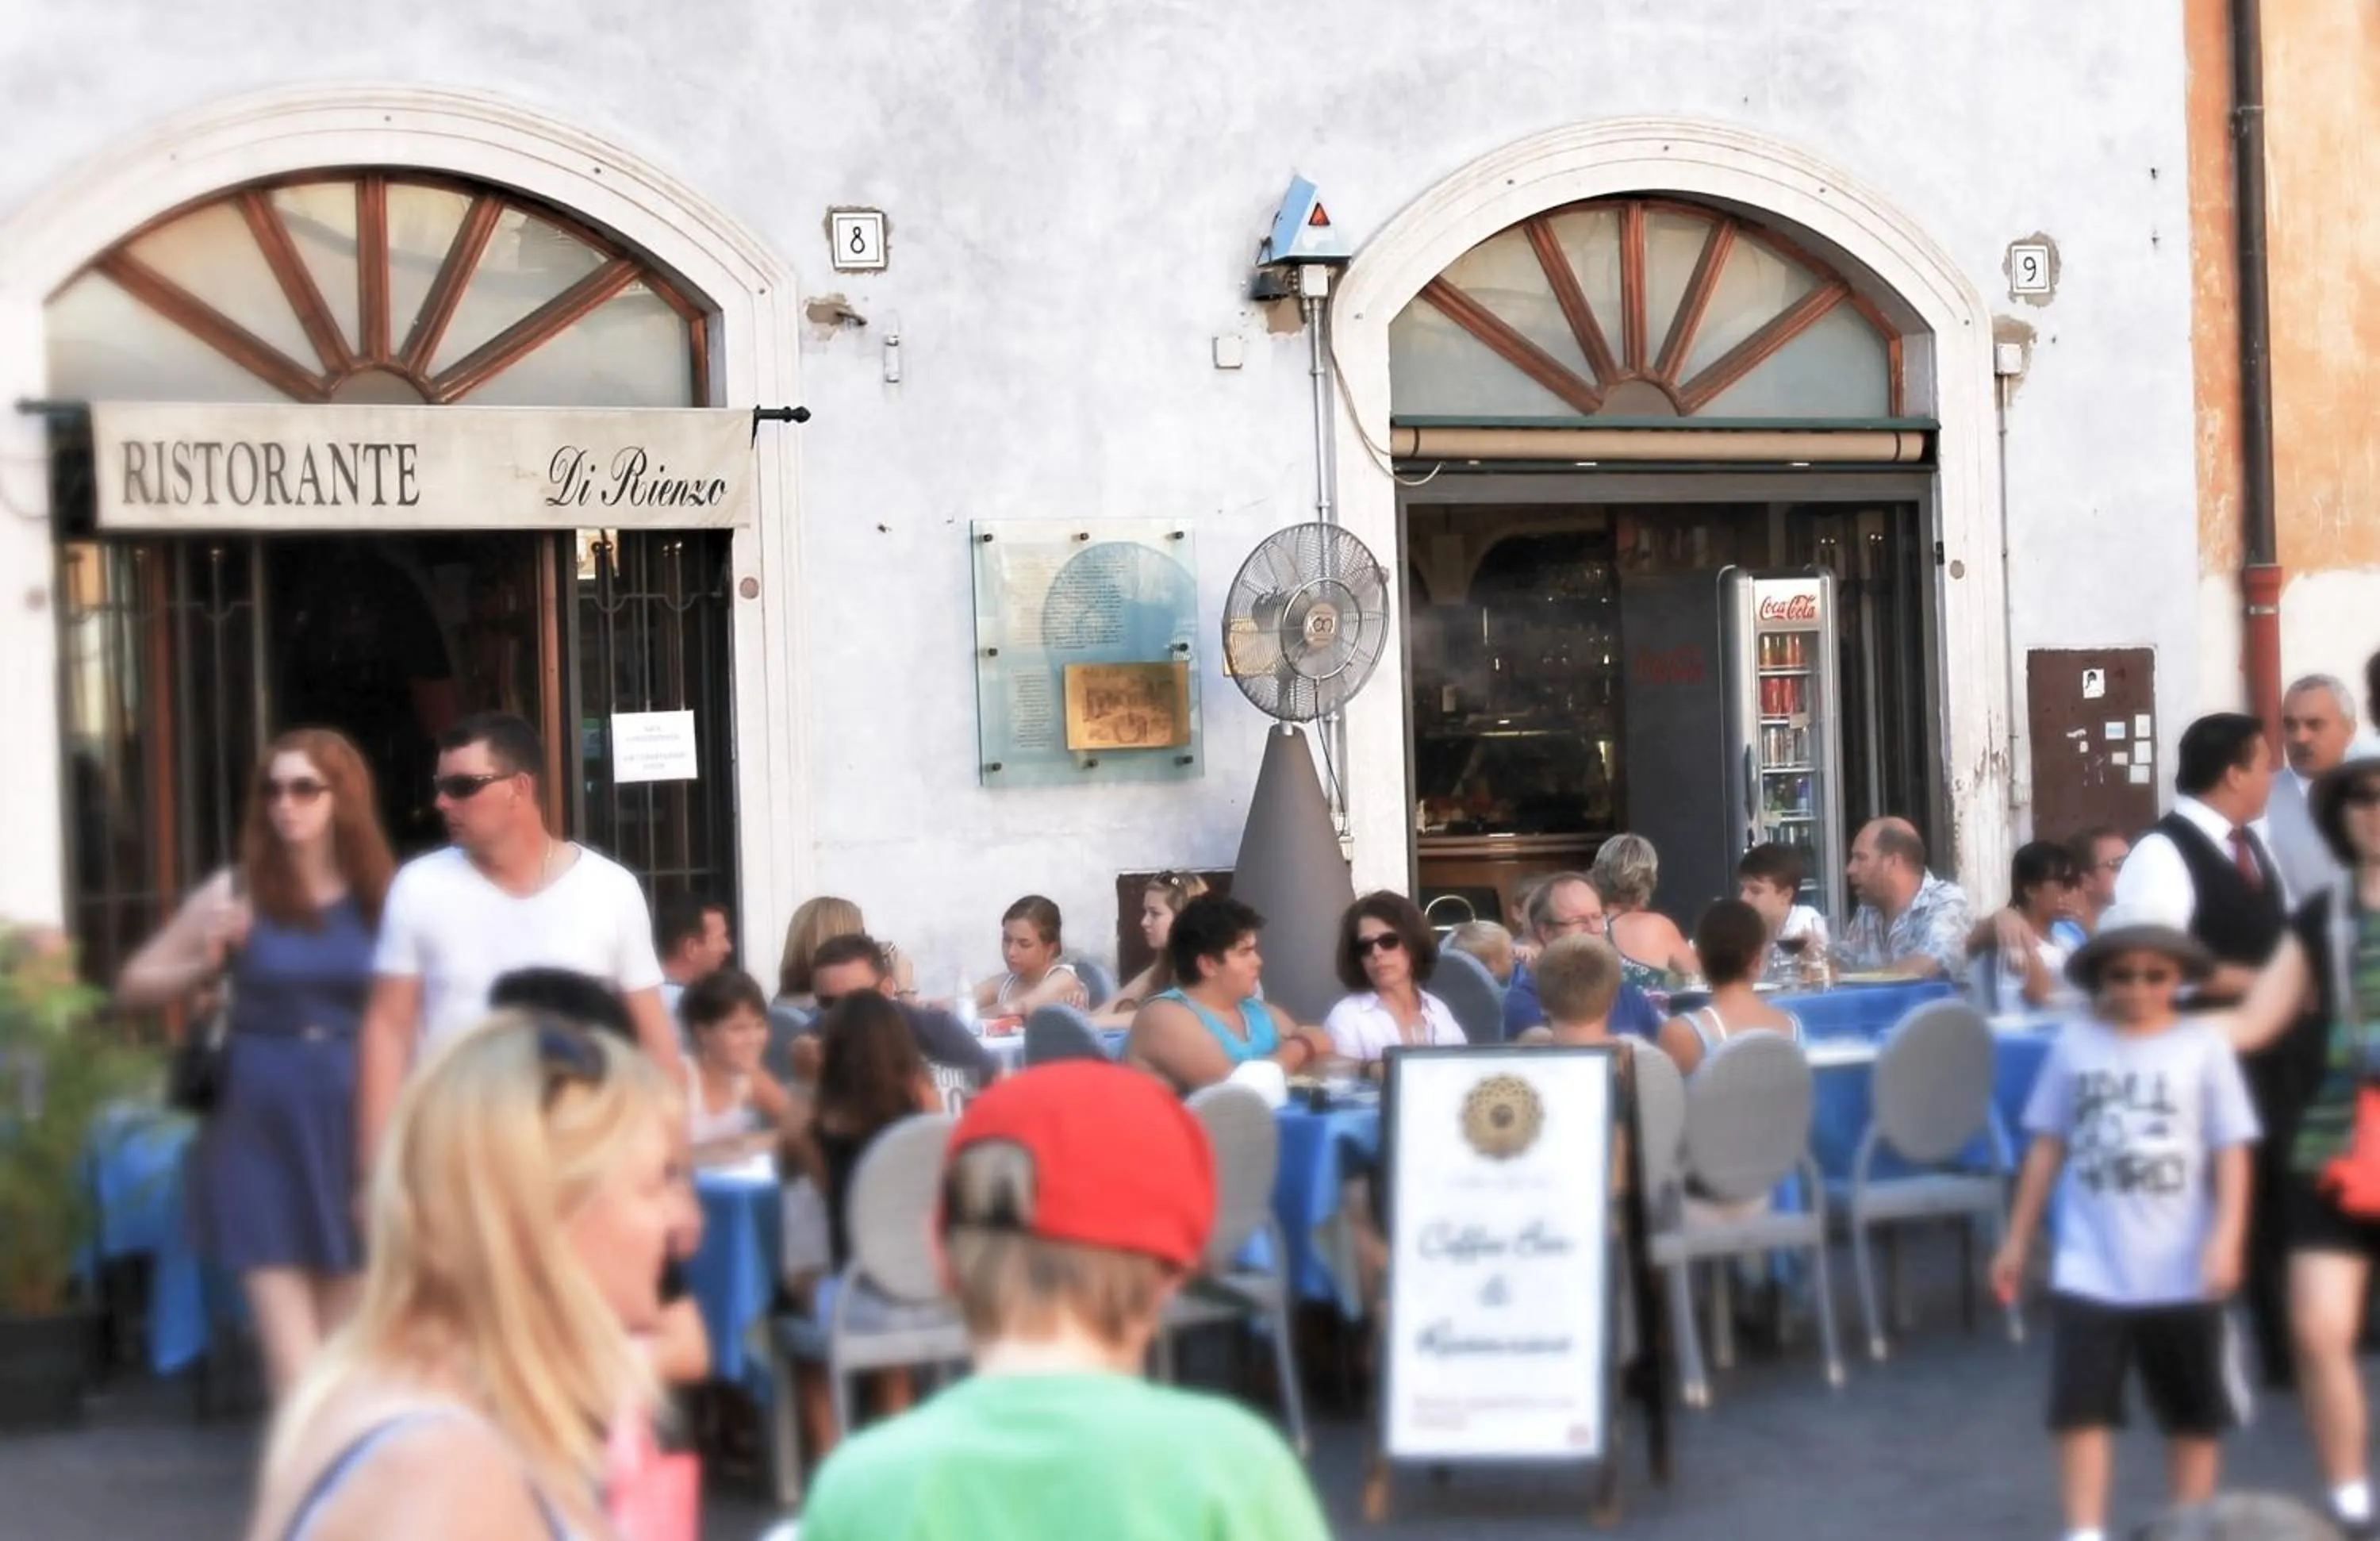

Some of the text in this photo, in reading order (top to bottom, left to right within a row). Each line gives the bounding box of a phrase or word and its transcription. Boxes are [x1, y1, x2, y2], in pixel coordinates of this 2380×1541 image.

[850, 226, 866, 255] 8
[2023, 256, 2036, 282] 9
[121, 440, 420, 506] RISTORANTE
[546, 445, 726, 506] Di Rienzo
